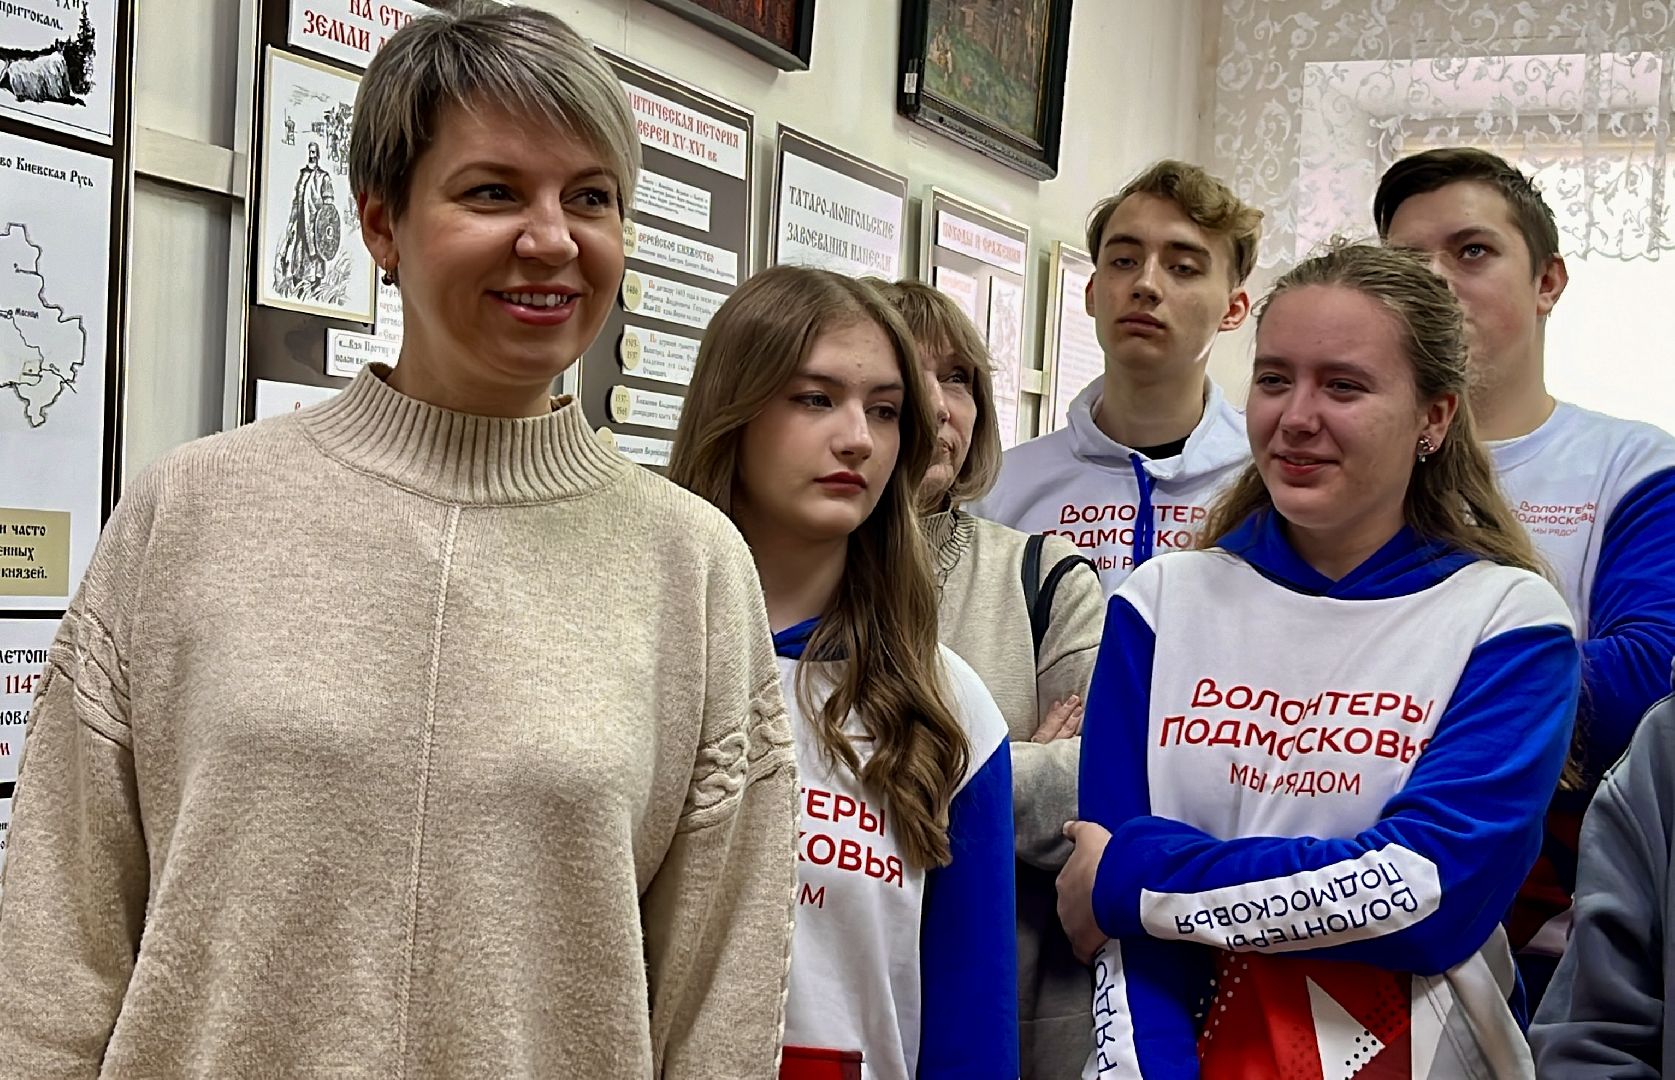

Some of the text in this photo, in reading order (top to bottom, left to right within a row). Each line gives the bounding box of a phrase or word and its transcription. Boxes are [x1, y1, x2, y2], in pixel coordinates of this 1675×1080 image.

[349, 0, 374, 21] НА
[303, 10, 370, 52] ЗЕМЛИ
[696, 119, 739, 149] ИСТОРИЯ
[16, 156, 67, 181] Киевская
[70, 170, 94, 188] Русь
[789, 185, 895, 240] ТАТАРО-МОНГОЛЬСКИЕ
[786, 222, 848, 259] ЗАВОЕВАНИЯ
[11, 524, 47, 537] часто
[1, 566, 48, 580] князей.
[1191, 678, 1434, 725] ВОЛОНТЕРЫ
[1229, 762, 1361, 797] МЫ РЯДОМ
[1174, 862, 1404, 935] ПОДМОСКОВЬЯ
[1225, 886, 1419, 951] ВОЛОНТЕРЫ
